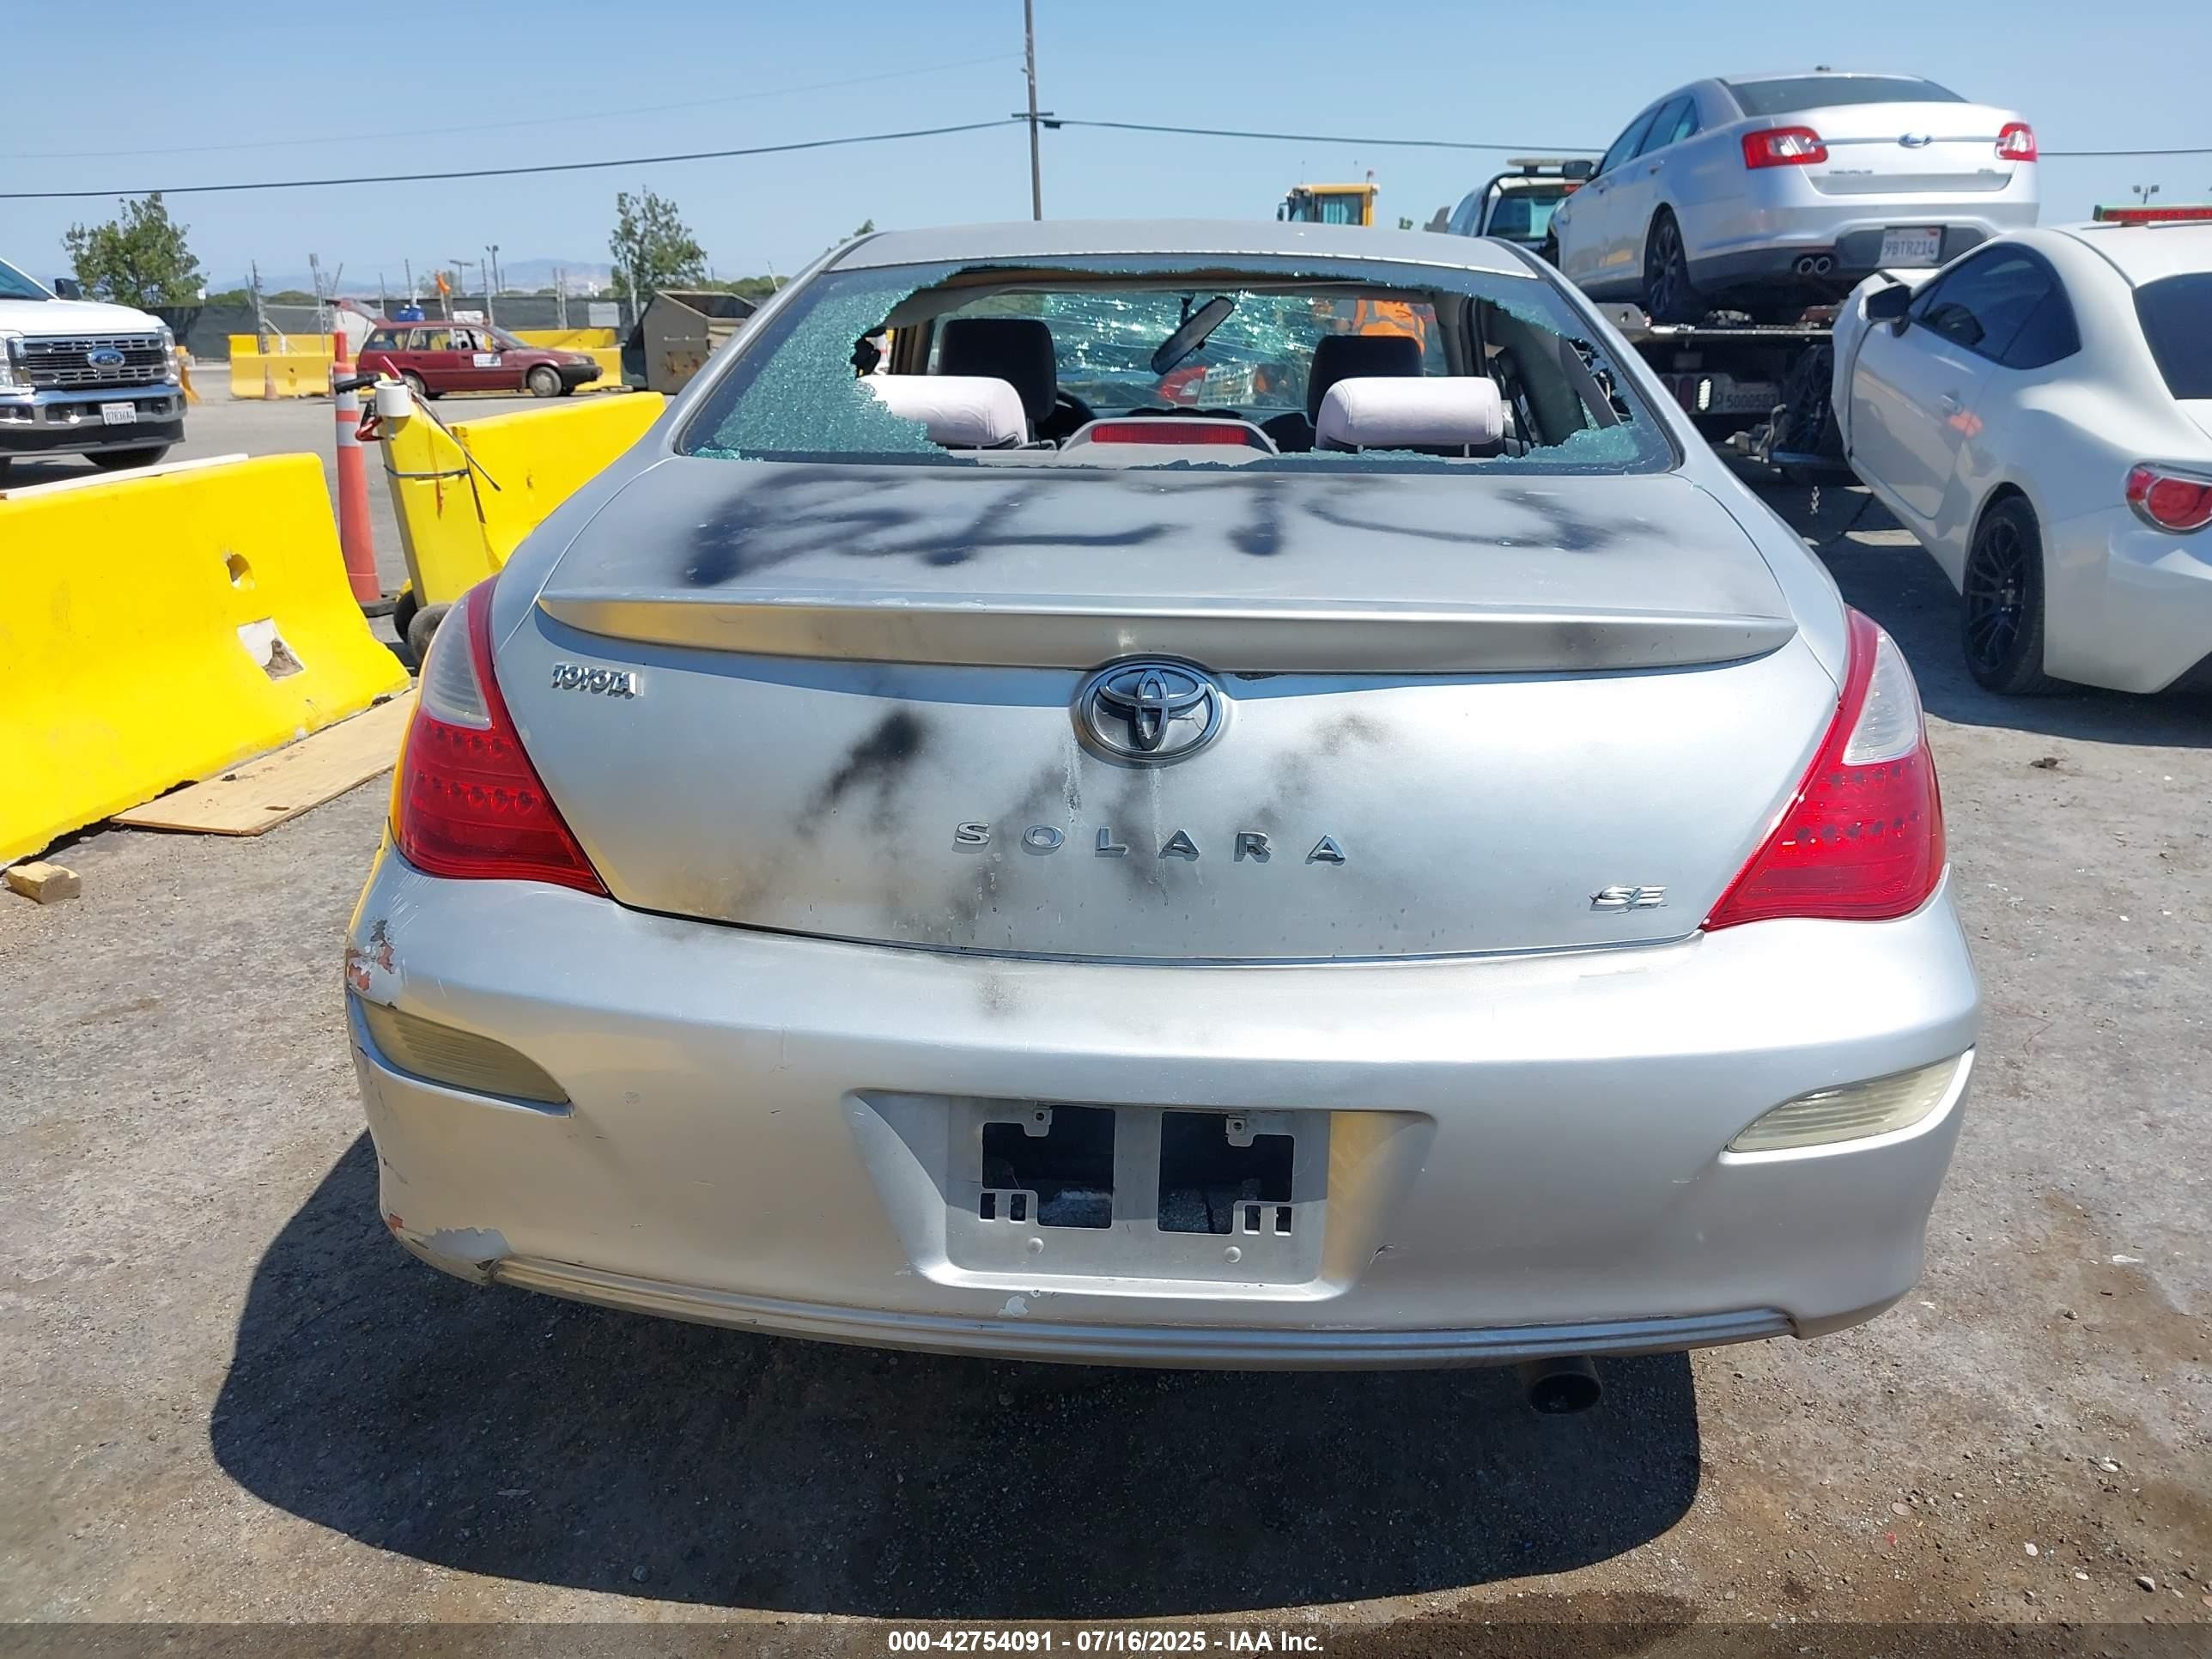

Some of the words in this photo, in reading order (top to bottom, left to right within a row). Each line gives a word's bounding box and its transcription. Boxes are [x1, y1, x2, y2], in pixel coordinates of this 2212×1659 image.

[551, 664, 637, 698] TOYOTA
[954, 821, 1346, 864] SOLARA
[1591, 885, 1667, 910] SE
